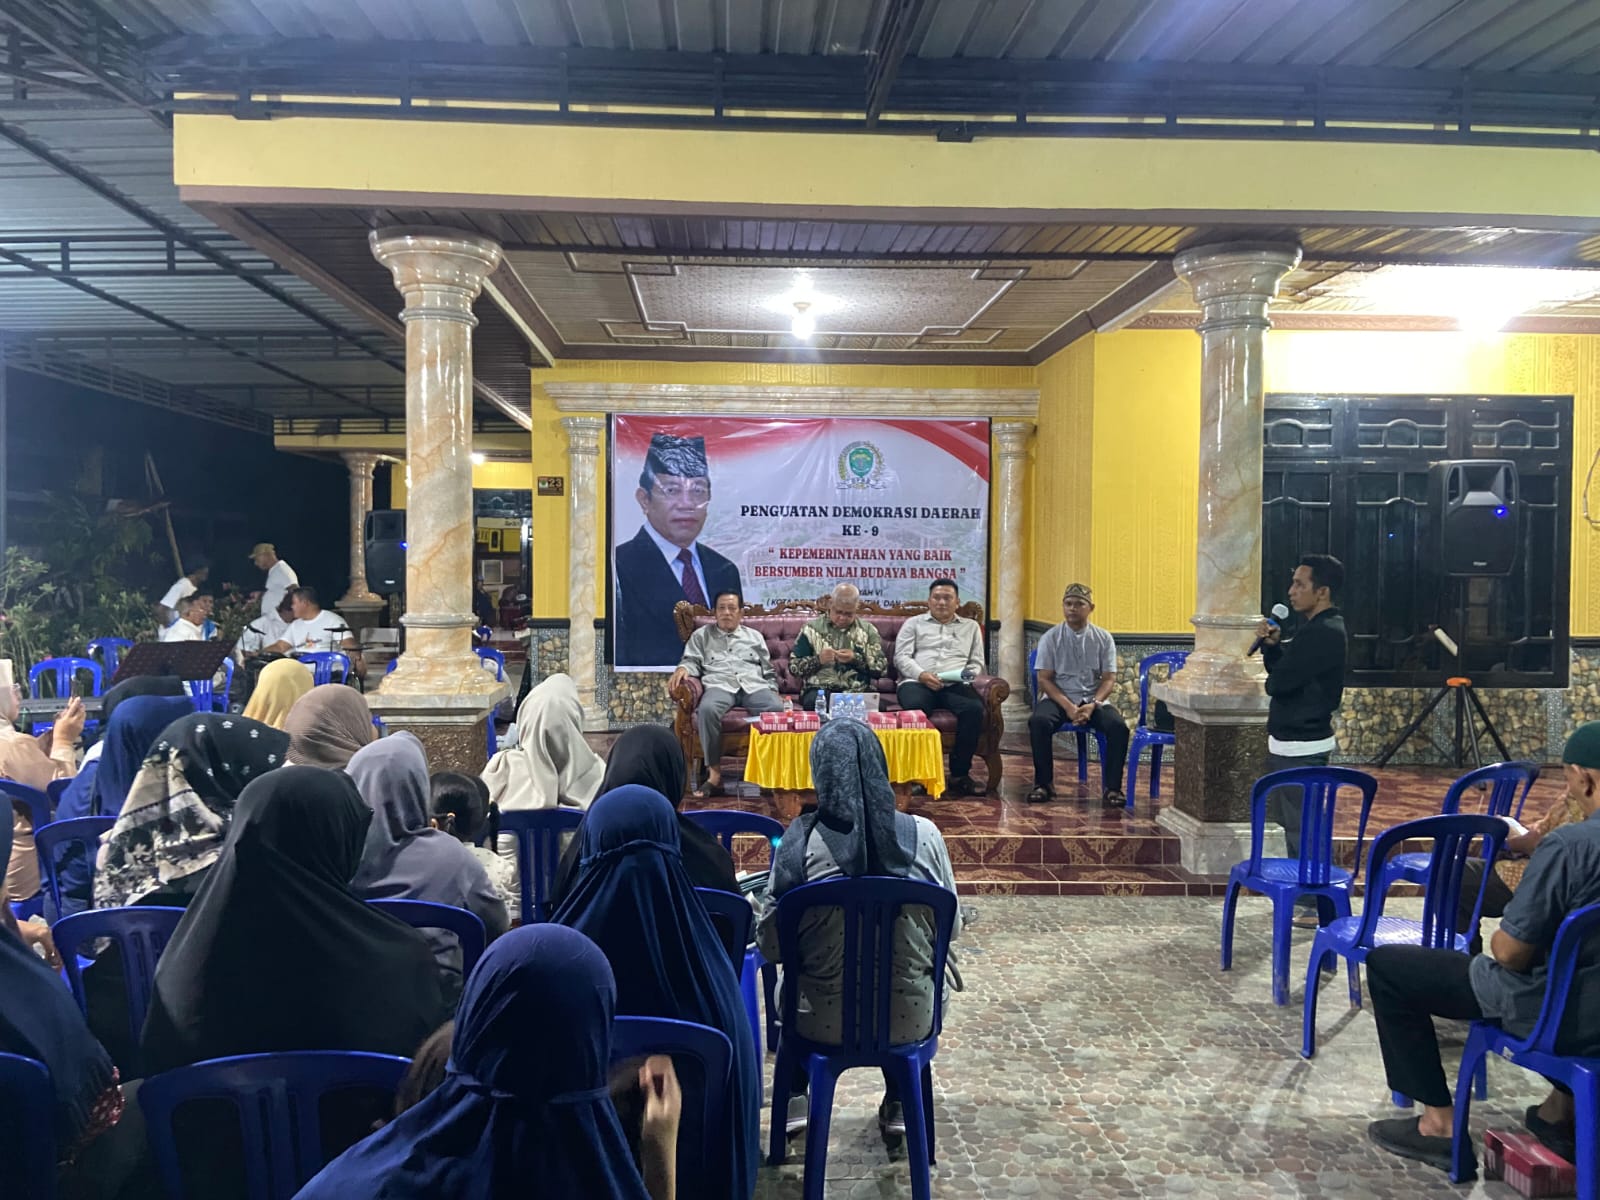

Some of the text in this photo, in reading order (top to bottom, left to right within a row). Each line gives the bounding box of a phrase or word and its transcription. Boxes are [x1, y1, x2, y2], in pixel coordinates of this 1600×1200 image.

[741, 505, 982, 519] PENGUATAN DEMOKRASI DAERAH
[842, 525, 861, 536] KE
[871, 526, 879, 537] 9
[780, 548, 886, 561] KEPEMERINTAHAN
[889, 549, 921, 561] YANG
[924, 549, 953, 561] BAIK
[755, 566, 823, 578] BERSUMBER
[826, 567, 857, 578] NILAI
[860, 567, 907, 579] BUDAYA
[911, 568, 957, 580] BANGSA
